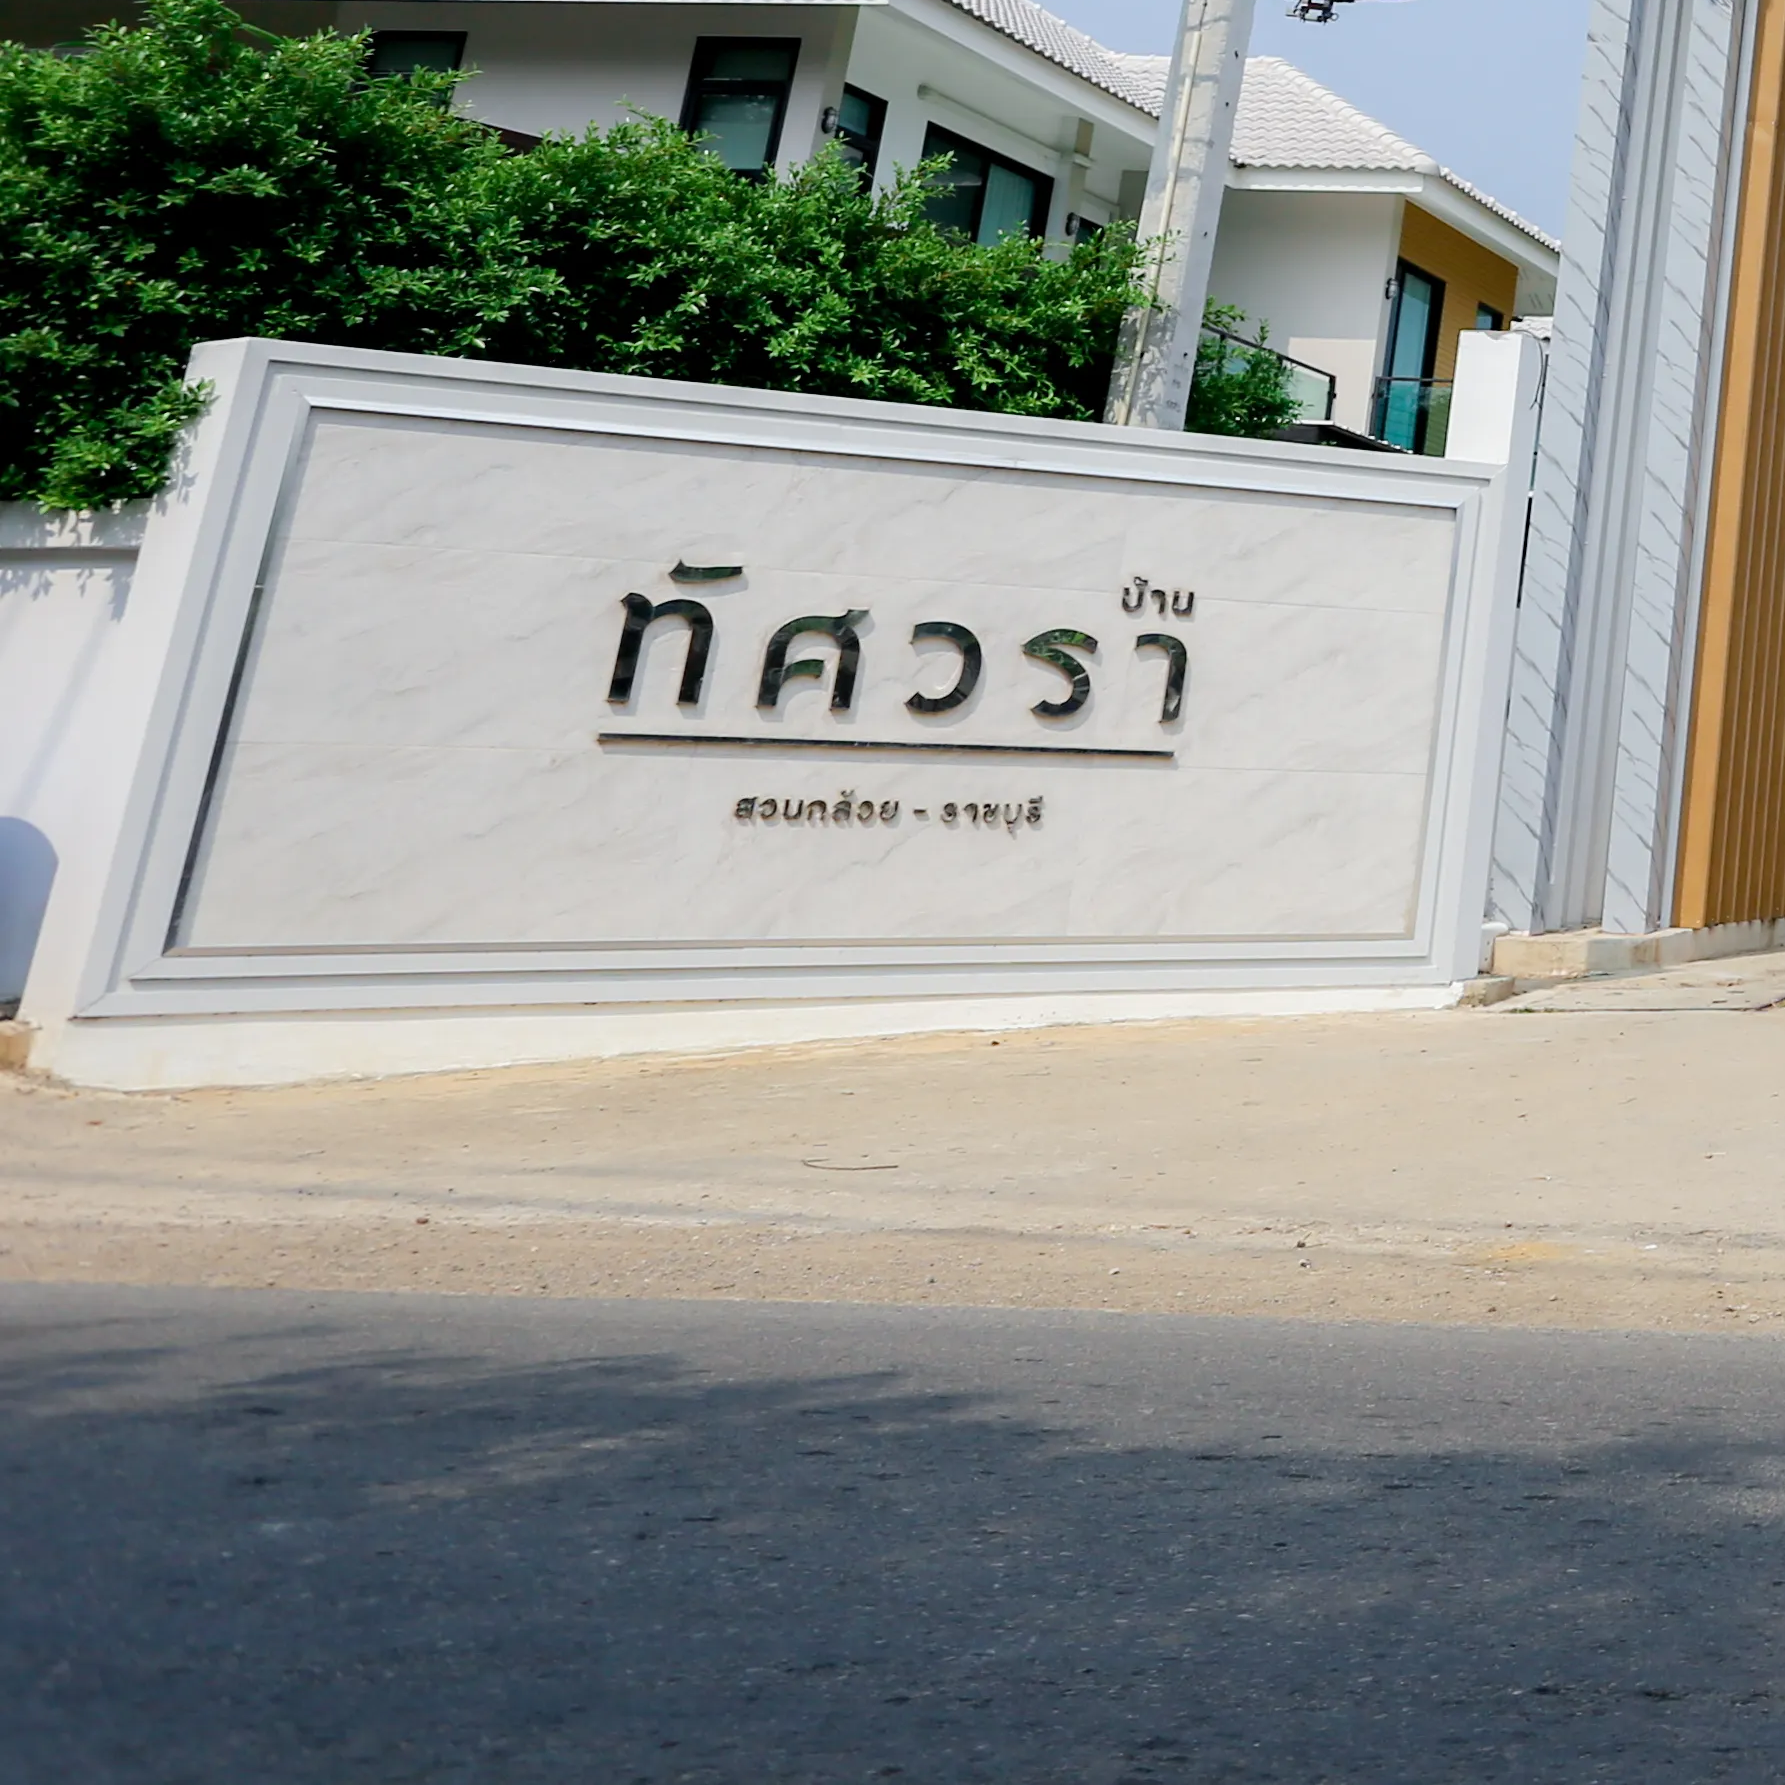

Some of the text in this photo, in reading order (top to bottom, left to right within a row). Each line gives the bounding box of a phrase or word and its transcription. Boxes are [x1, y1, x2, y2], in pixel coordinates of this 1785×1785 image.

[1121, 575, 1195, 618] บ้าน
[604, 559, 1188, 723] ทัศวรา
[734, 789, 899, 822] สวนกล้วย
[940, 795, 1044, 834] ราชบุรี
